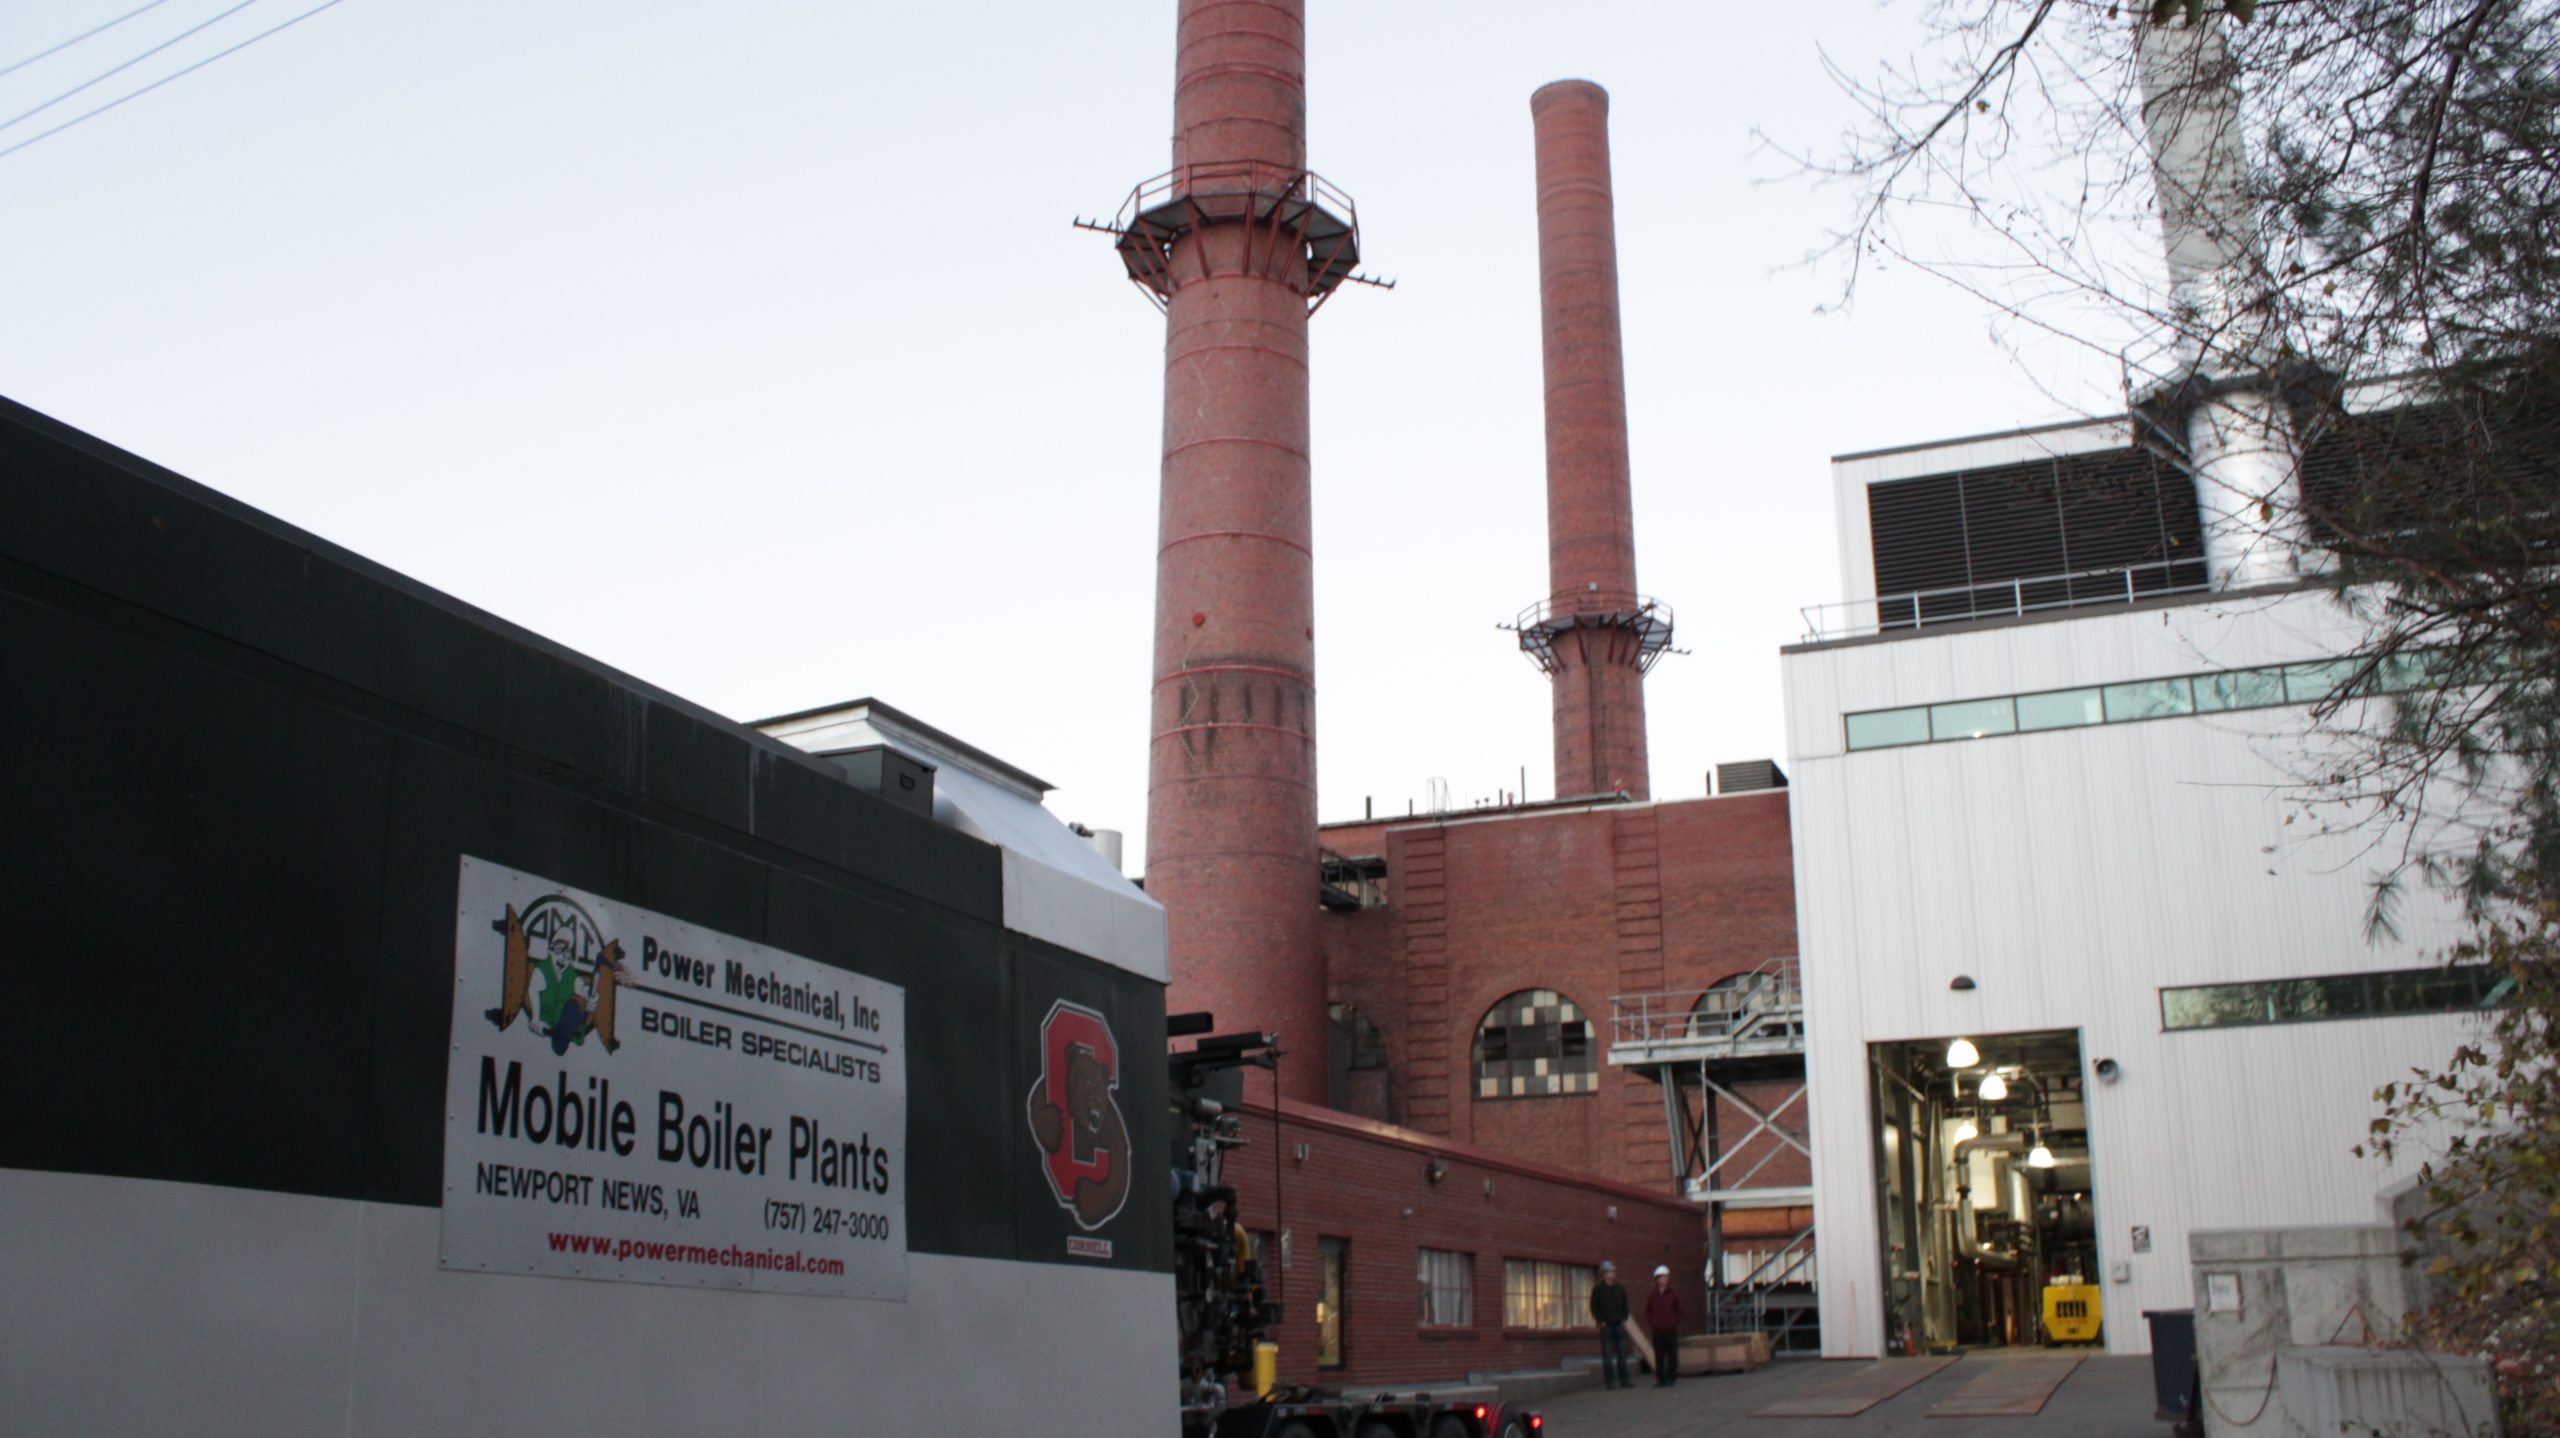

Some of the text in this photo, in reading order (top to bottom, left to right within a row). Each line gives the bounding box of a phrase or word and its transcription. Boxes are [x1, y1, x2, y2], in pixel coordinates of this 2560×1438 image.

[642, 935, 881, 1033] Power Mechanical, Inc
[641, 1006, 881, 1083] BOILER SPECIALISTS
[477, 1055, 889, 1195] Mobile Boiler Plants
[476, 1161, 701, 1222] NEWPORT NEWS, VA
[764, 1197, 889, 1241] (757) 247-3000
[547, 1231, 845, 1276] www.powermechanical.com
